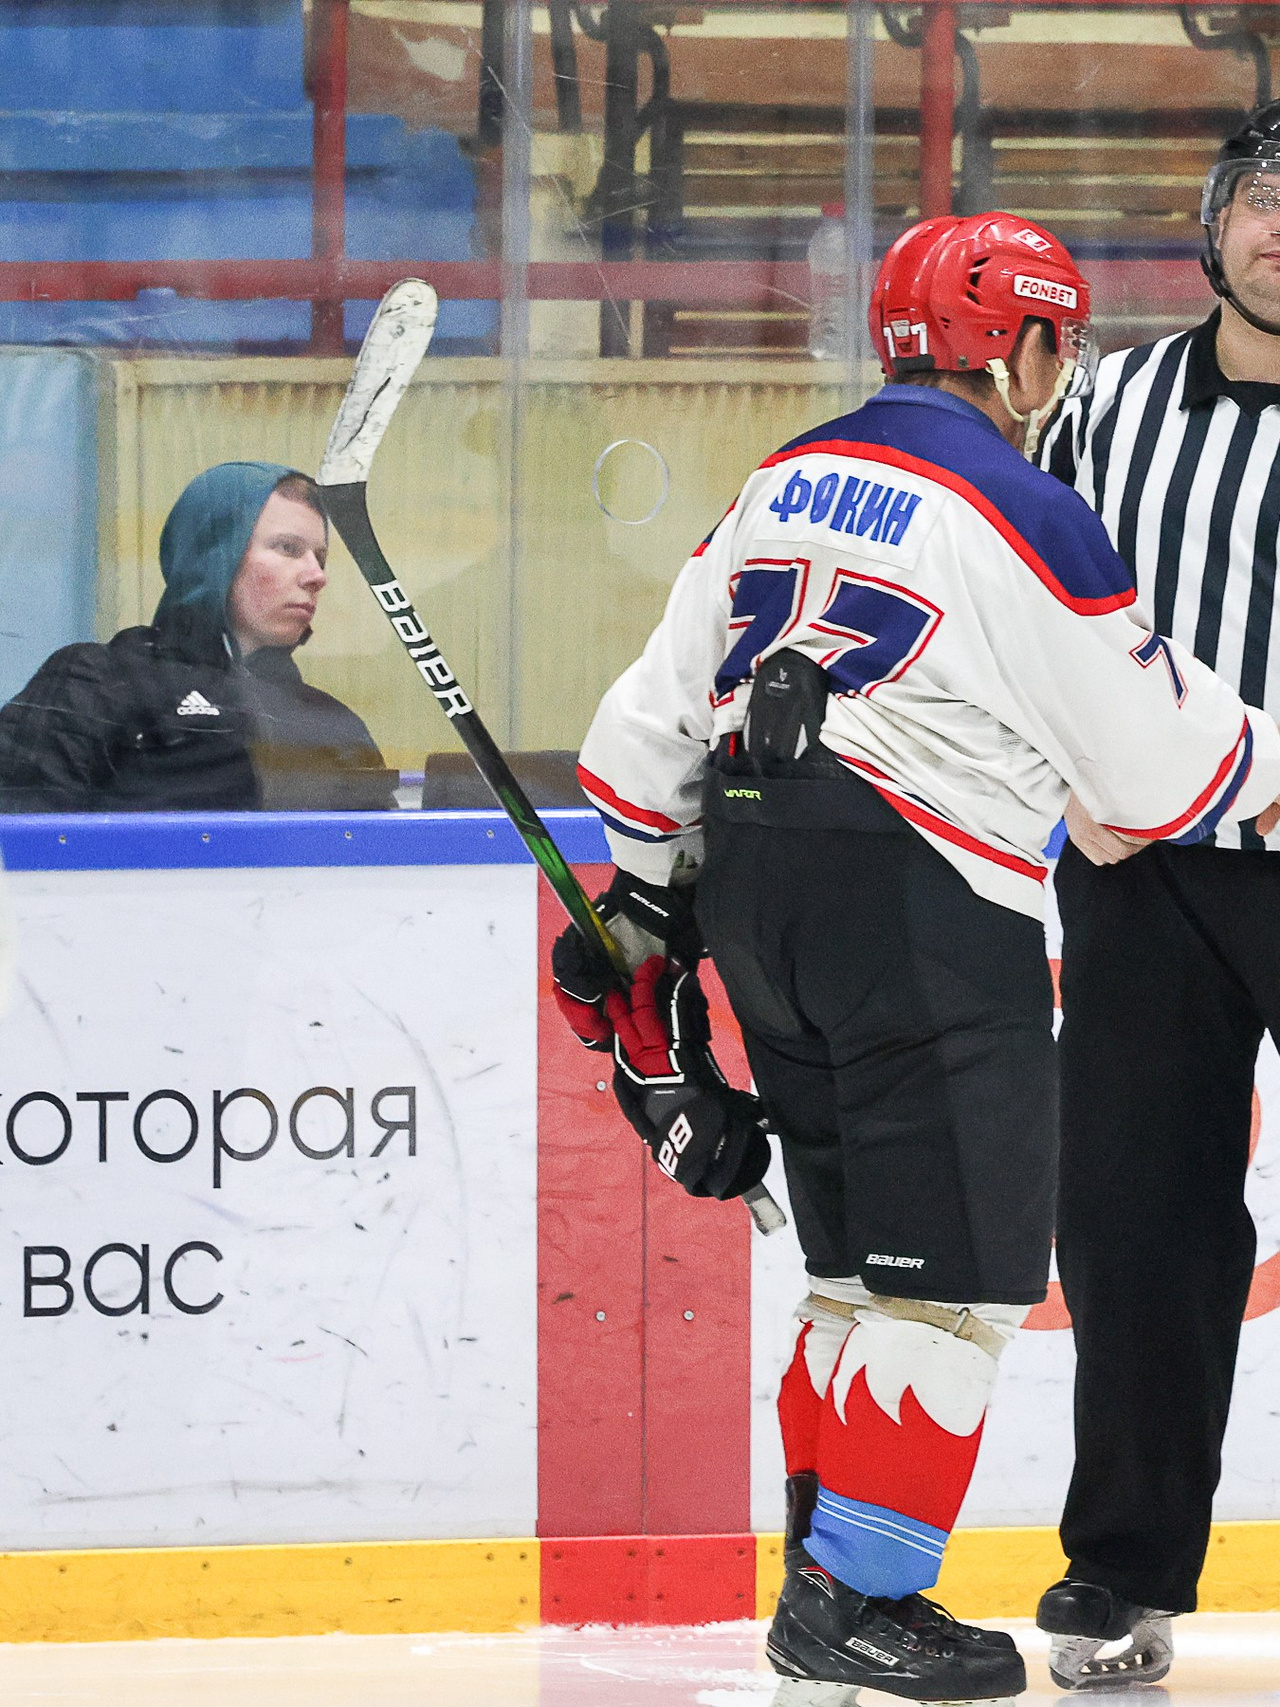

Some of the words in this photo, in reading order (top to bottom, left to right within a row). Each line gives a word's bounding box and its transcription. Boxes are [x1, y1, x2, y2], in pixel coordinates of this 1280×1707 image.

[1020, 280, 1073, 304] FONBET
[769, 469, 923, 546] ФОКИН
[708, 557, 945, 712] 77
[0, 1086, 417, 1189] оторая
[23, 1240, 224, 1317] вас
[865, 1253, 925, 1269] BAUER
